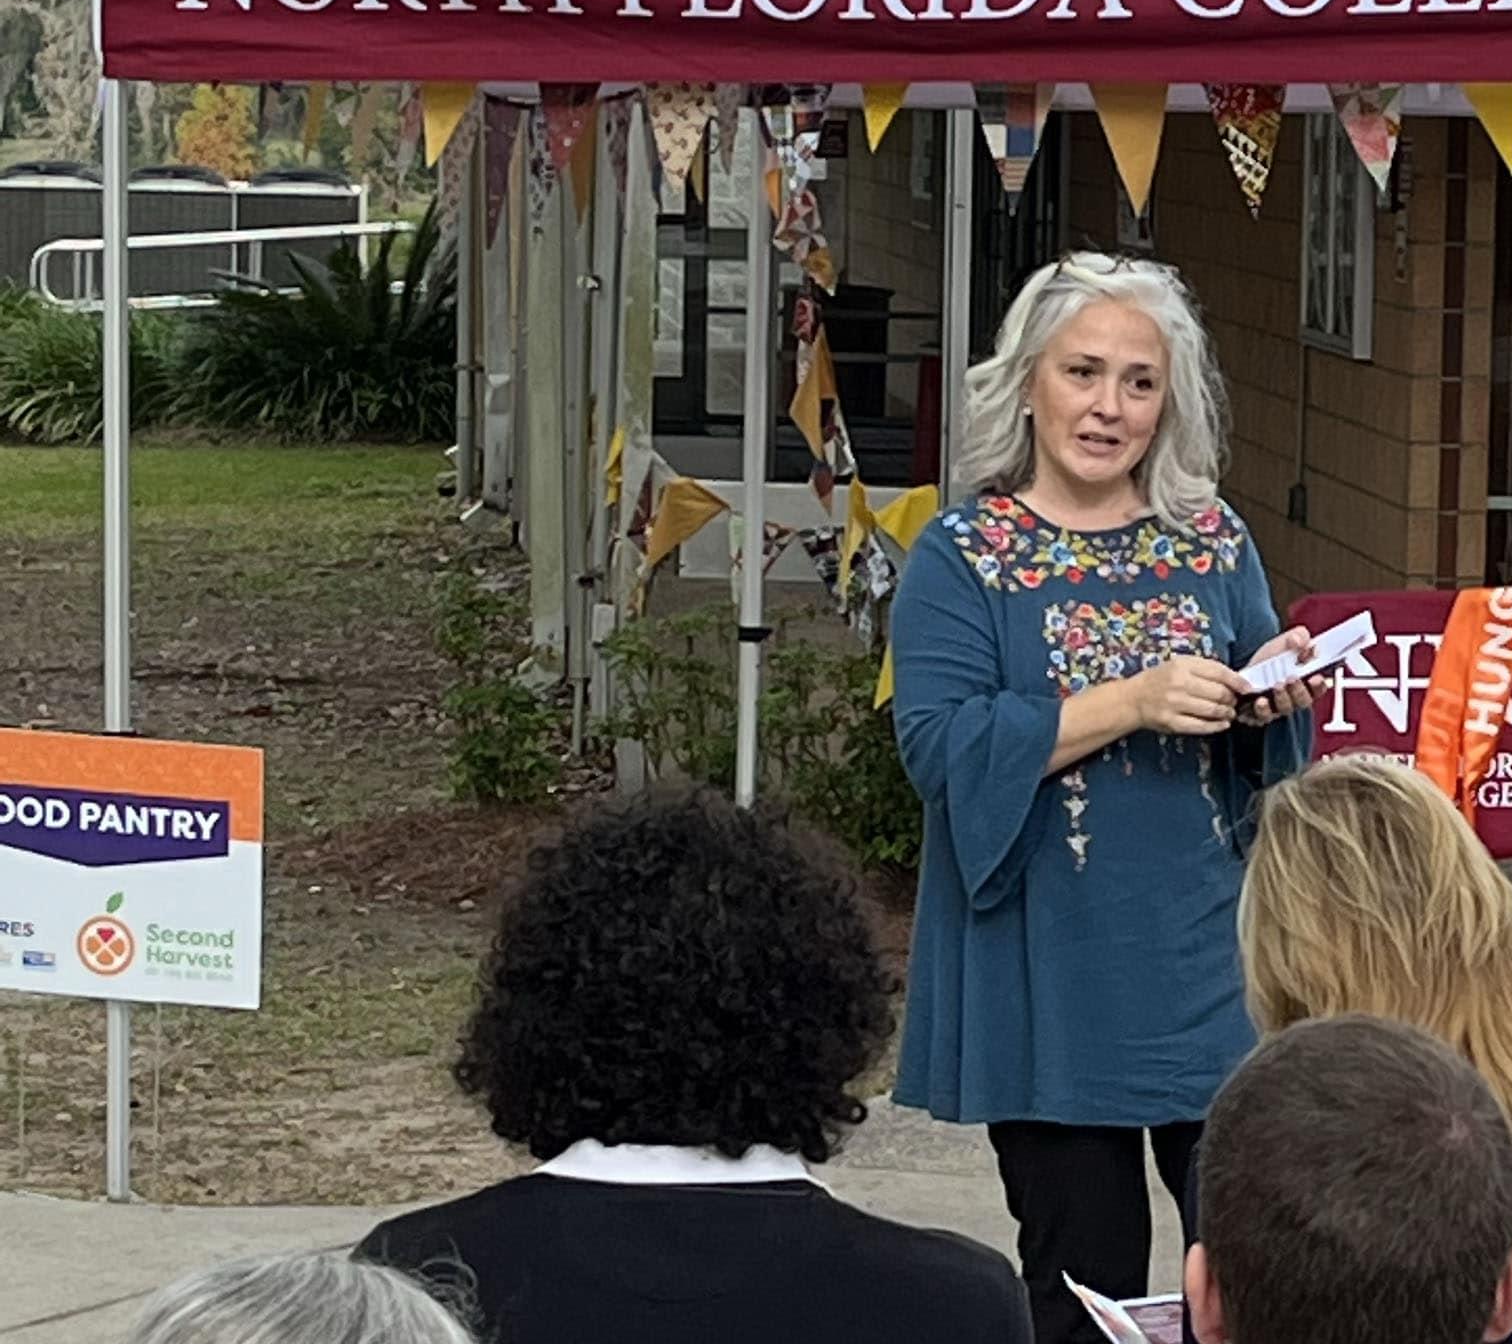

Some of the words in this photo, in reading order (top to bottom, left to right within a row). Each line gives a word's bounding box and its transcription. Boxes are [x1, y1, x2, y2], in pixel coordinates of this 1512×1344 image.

[0, 794, 71, 828] OOD
[79, 801, 221, 842] PANTRY
[0, 921, 35, 938] RES
[146, 923, 235, 948] Second
[146, 945, 234, 969] Harvest
